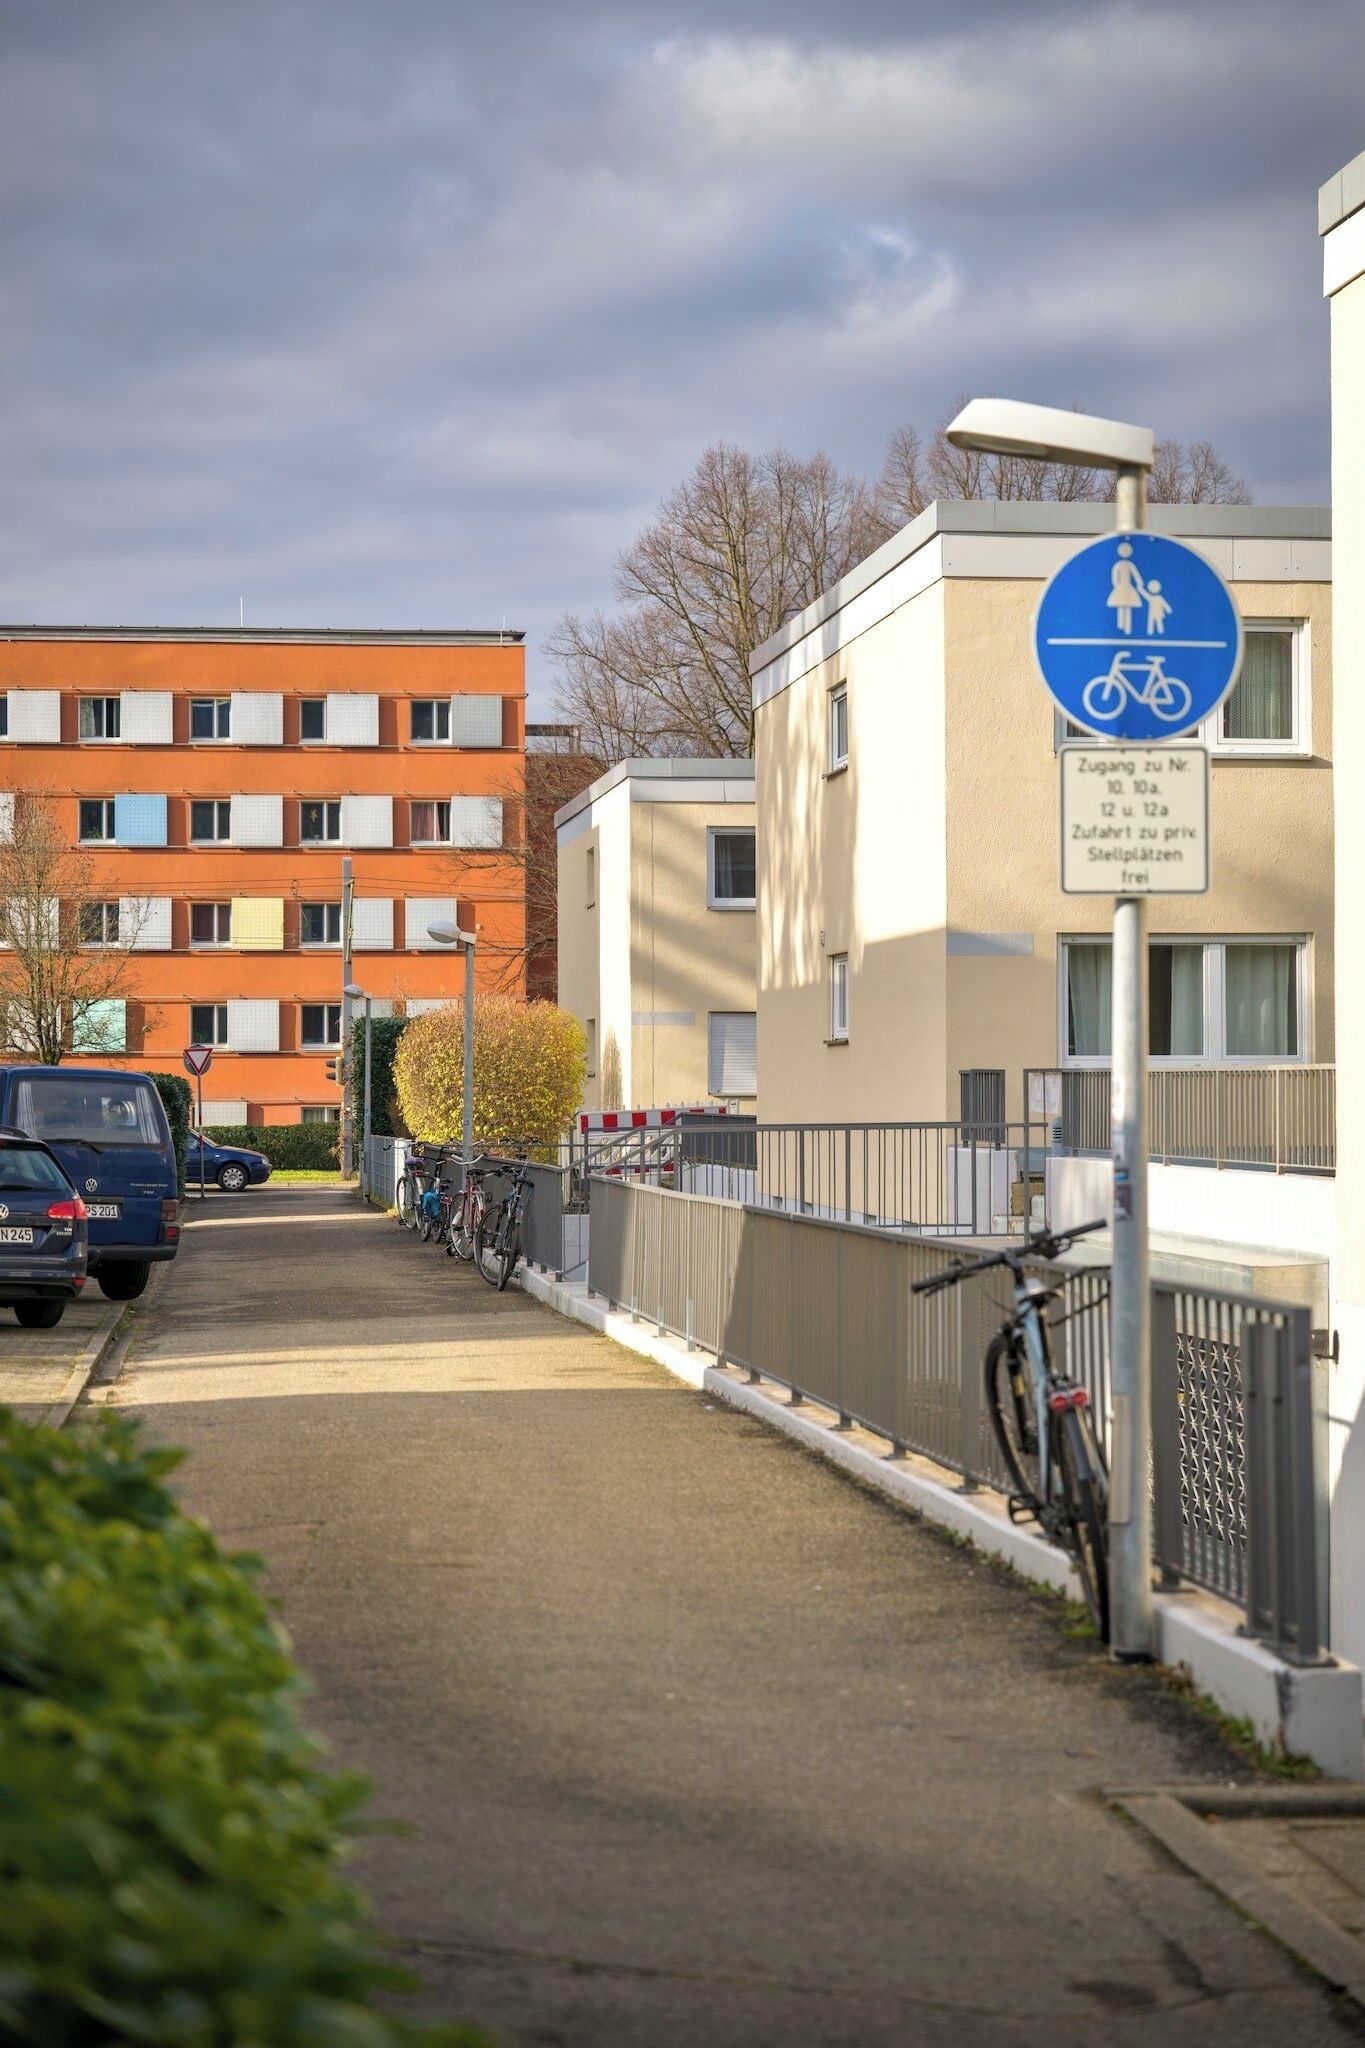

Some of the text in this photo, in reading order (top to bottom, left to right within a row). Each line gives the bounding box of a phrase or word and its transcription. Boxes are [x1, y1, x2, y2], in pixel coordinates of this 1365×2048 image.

[1078, 757, 1191, 776] Zugang zu Nr.
[1101, 802, 1116, 817] 12
[1144, 802, 1169, 817] 12a
[1072, 823, 1132, 840] Zufahrt
[1139, 827, 1158, 839] zu
[1087, 846, 1183, 864] Stellplätzen
[1121, 869, 1150, 884] frei
[99, 1206, 117, 1217] 201
[10, 1229, 32, 1241] 245
